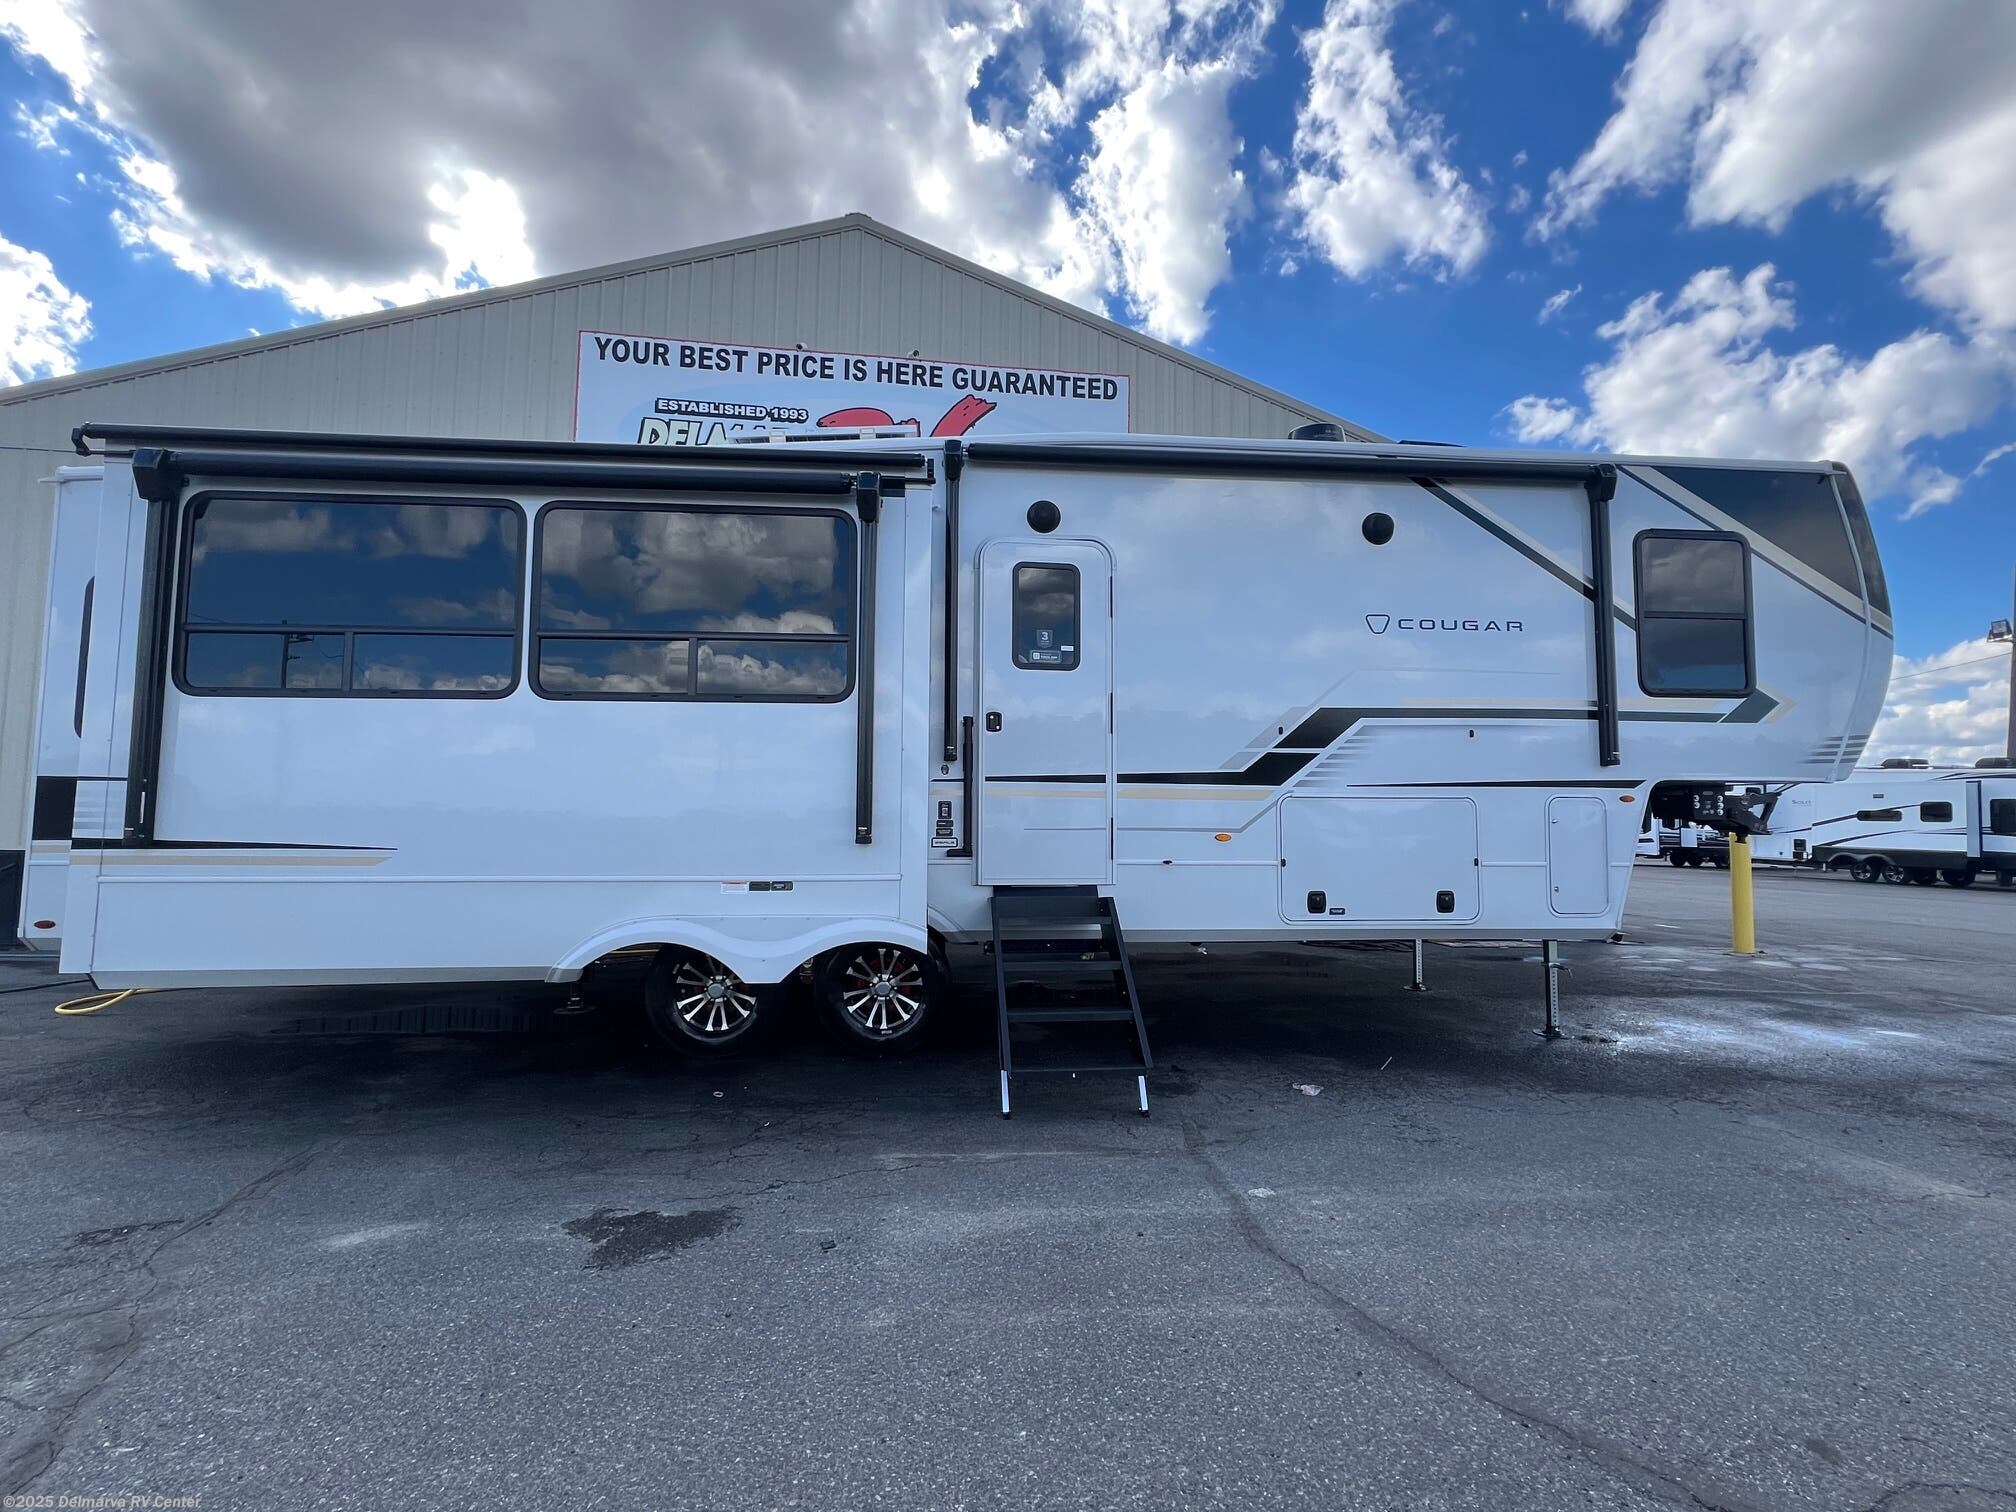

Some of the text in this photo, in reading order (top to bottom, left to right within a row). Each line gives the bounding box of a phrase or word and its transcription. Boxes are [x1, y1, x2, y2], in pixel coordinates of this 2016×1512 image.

[594, 336, 1119, 400] YOUR BEST PRICE IS HERE GUARANTEED
[656, 399, 809, 421] ESTABLISHED 1993
[1397, 618, 1523, 632] COUGAR
